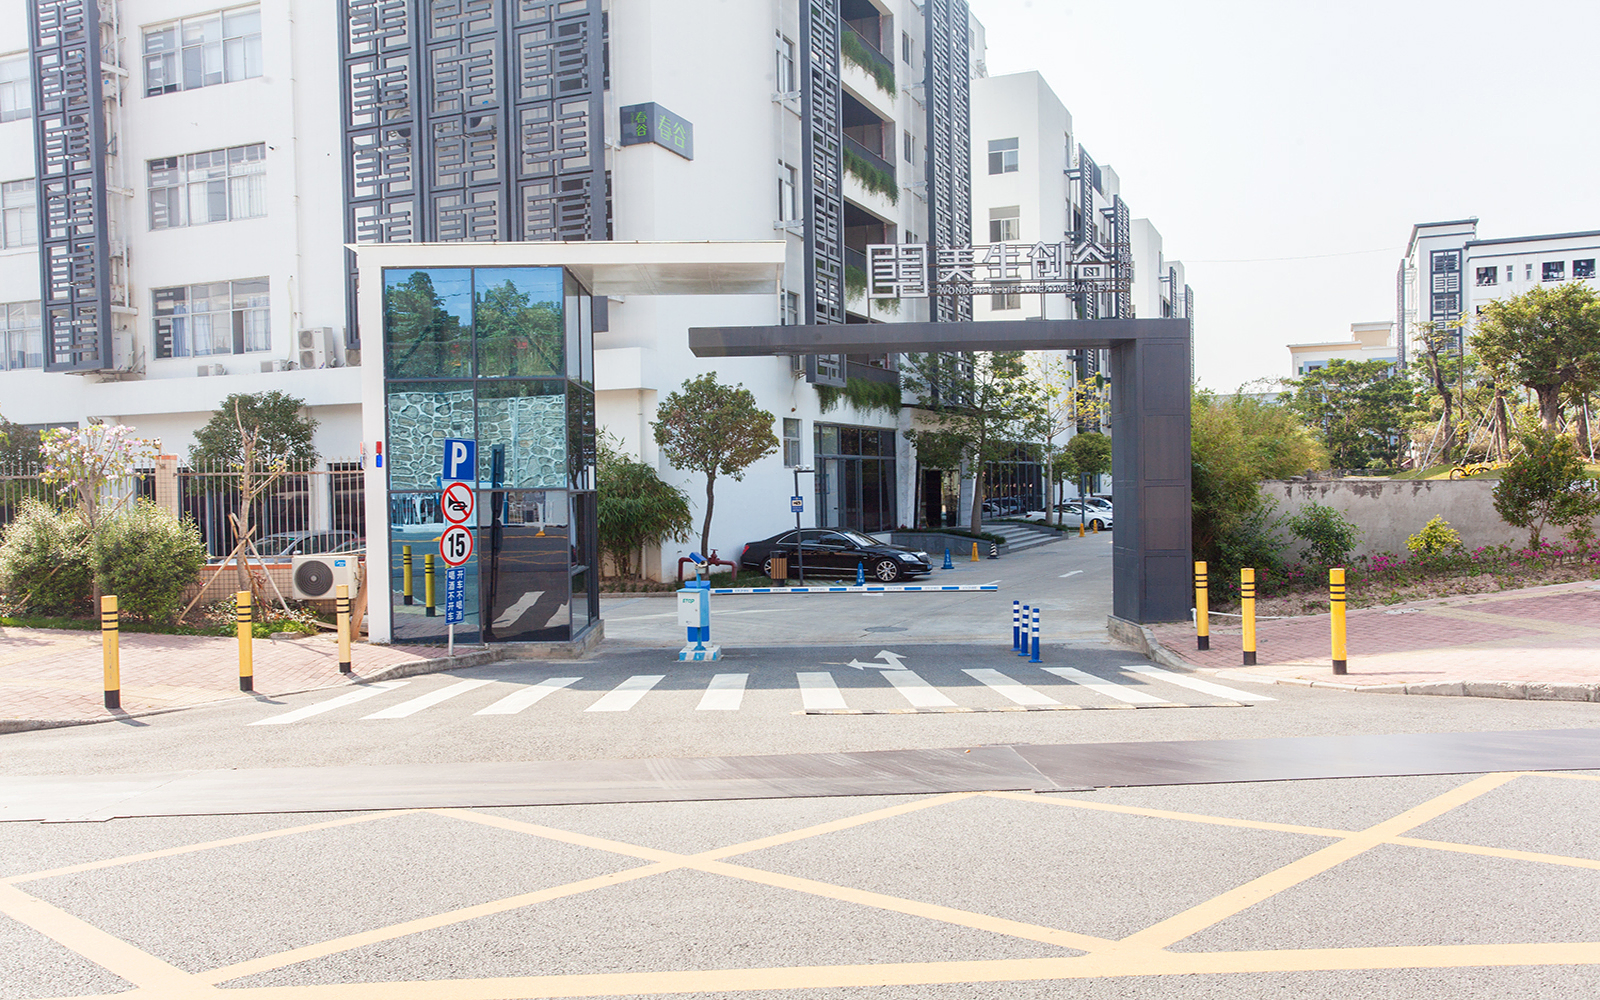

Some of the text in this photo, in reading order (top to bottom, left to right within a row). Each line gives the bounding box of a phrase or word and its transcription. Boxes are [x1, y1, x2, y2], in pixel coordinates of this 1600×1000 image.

[635, 111, 647, 136] 春谷
[658, 115, 686, 148] 春谷
[938, 241, 1110, 282] 美生创谷
[937, 283, 1111, 295] WONDERFUL LIFE CREATIVE VALLEY
[450, 441, 468, 478] P
[448, 533, 465, 558] 15
[447, 570, 456, 621] 喝酒不开车
[455, 570, 464, 620] 开车不喝酒
